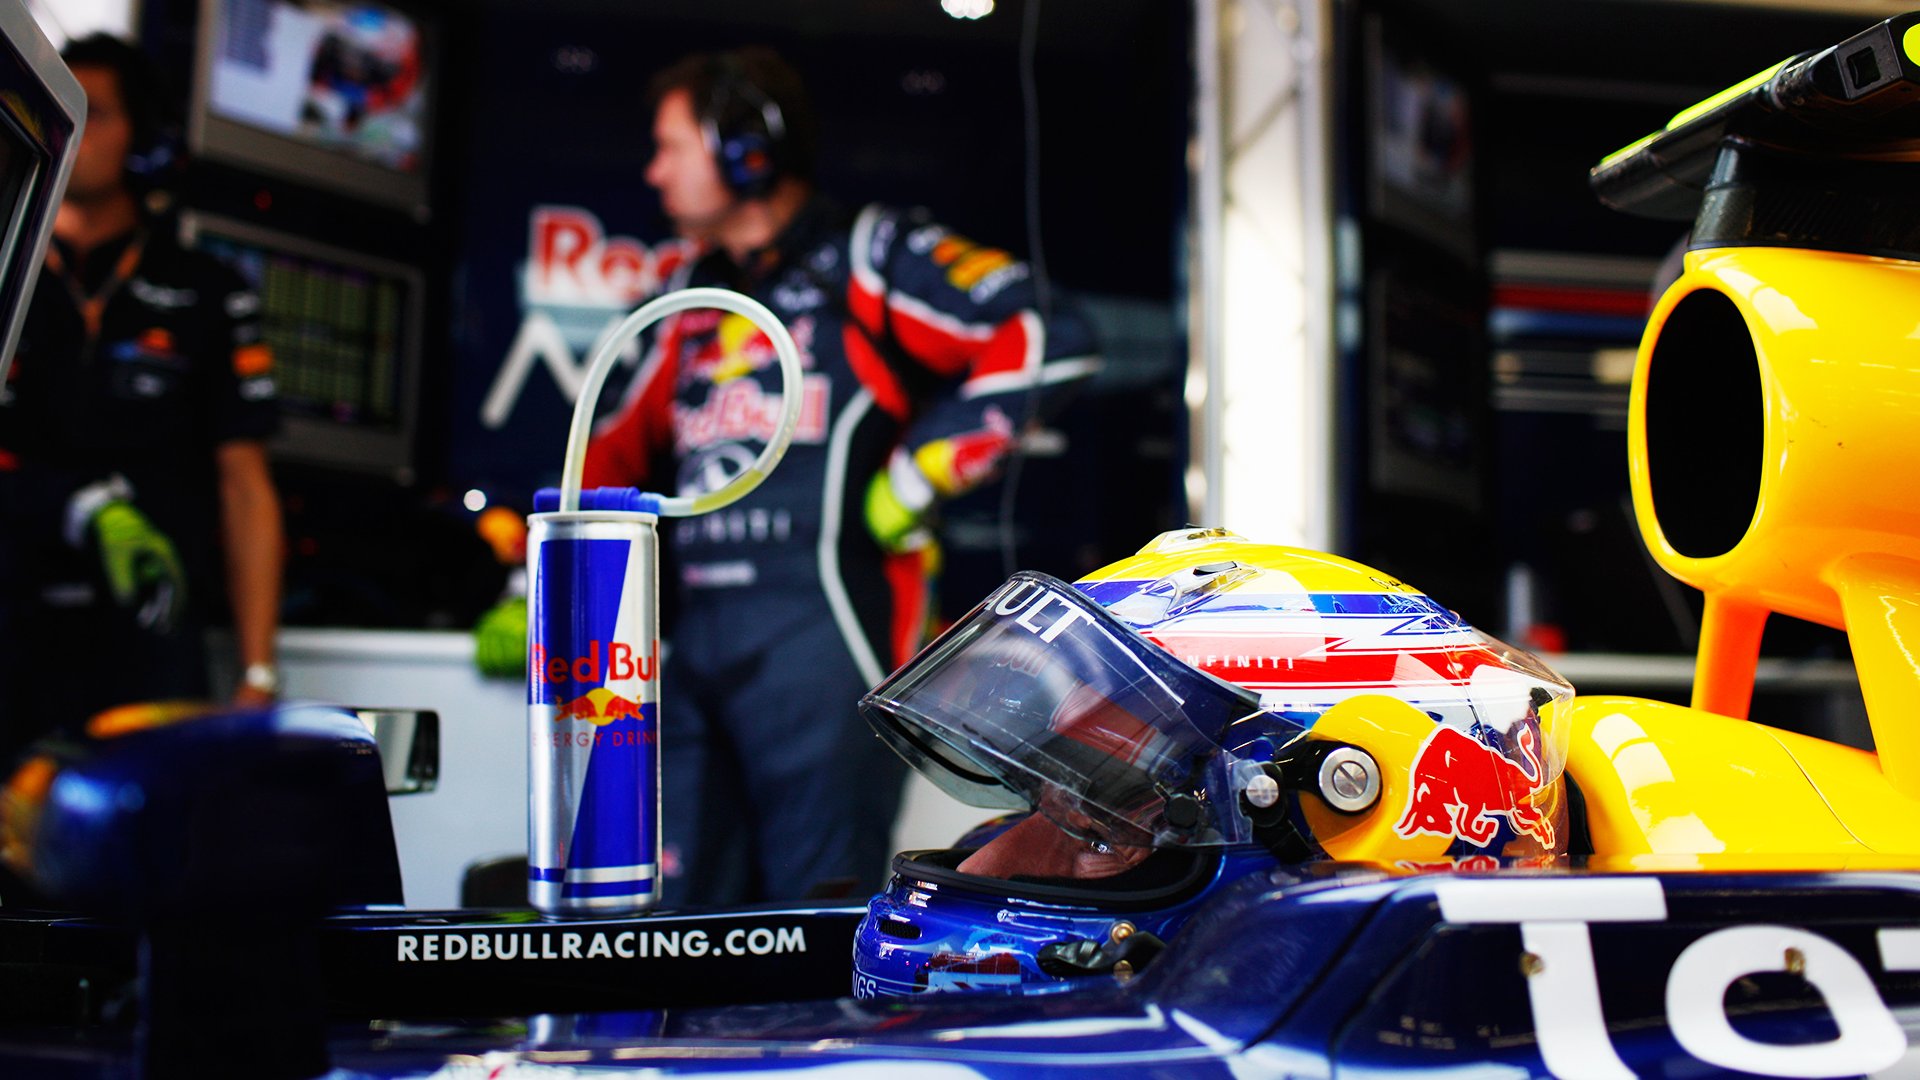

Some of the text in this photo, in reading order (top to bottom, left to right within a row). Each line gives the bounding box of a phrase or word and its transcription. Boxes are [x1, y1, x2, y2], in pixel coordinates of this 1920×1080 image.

[531, 640, 660, 683] Red Bul
[1186, 655, 1294, 670] NFINITI
[532, 731, 656, 748] EERGY DRIN
[397, 927, 807, 962] REDBULLRACING.COM
[852, 970, 877, 1000] NGS
